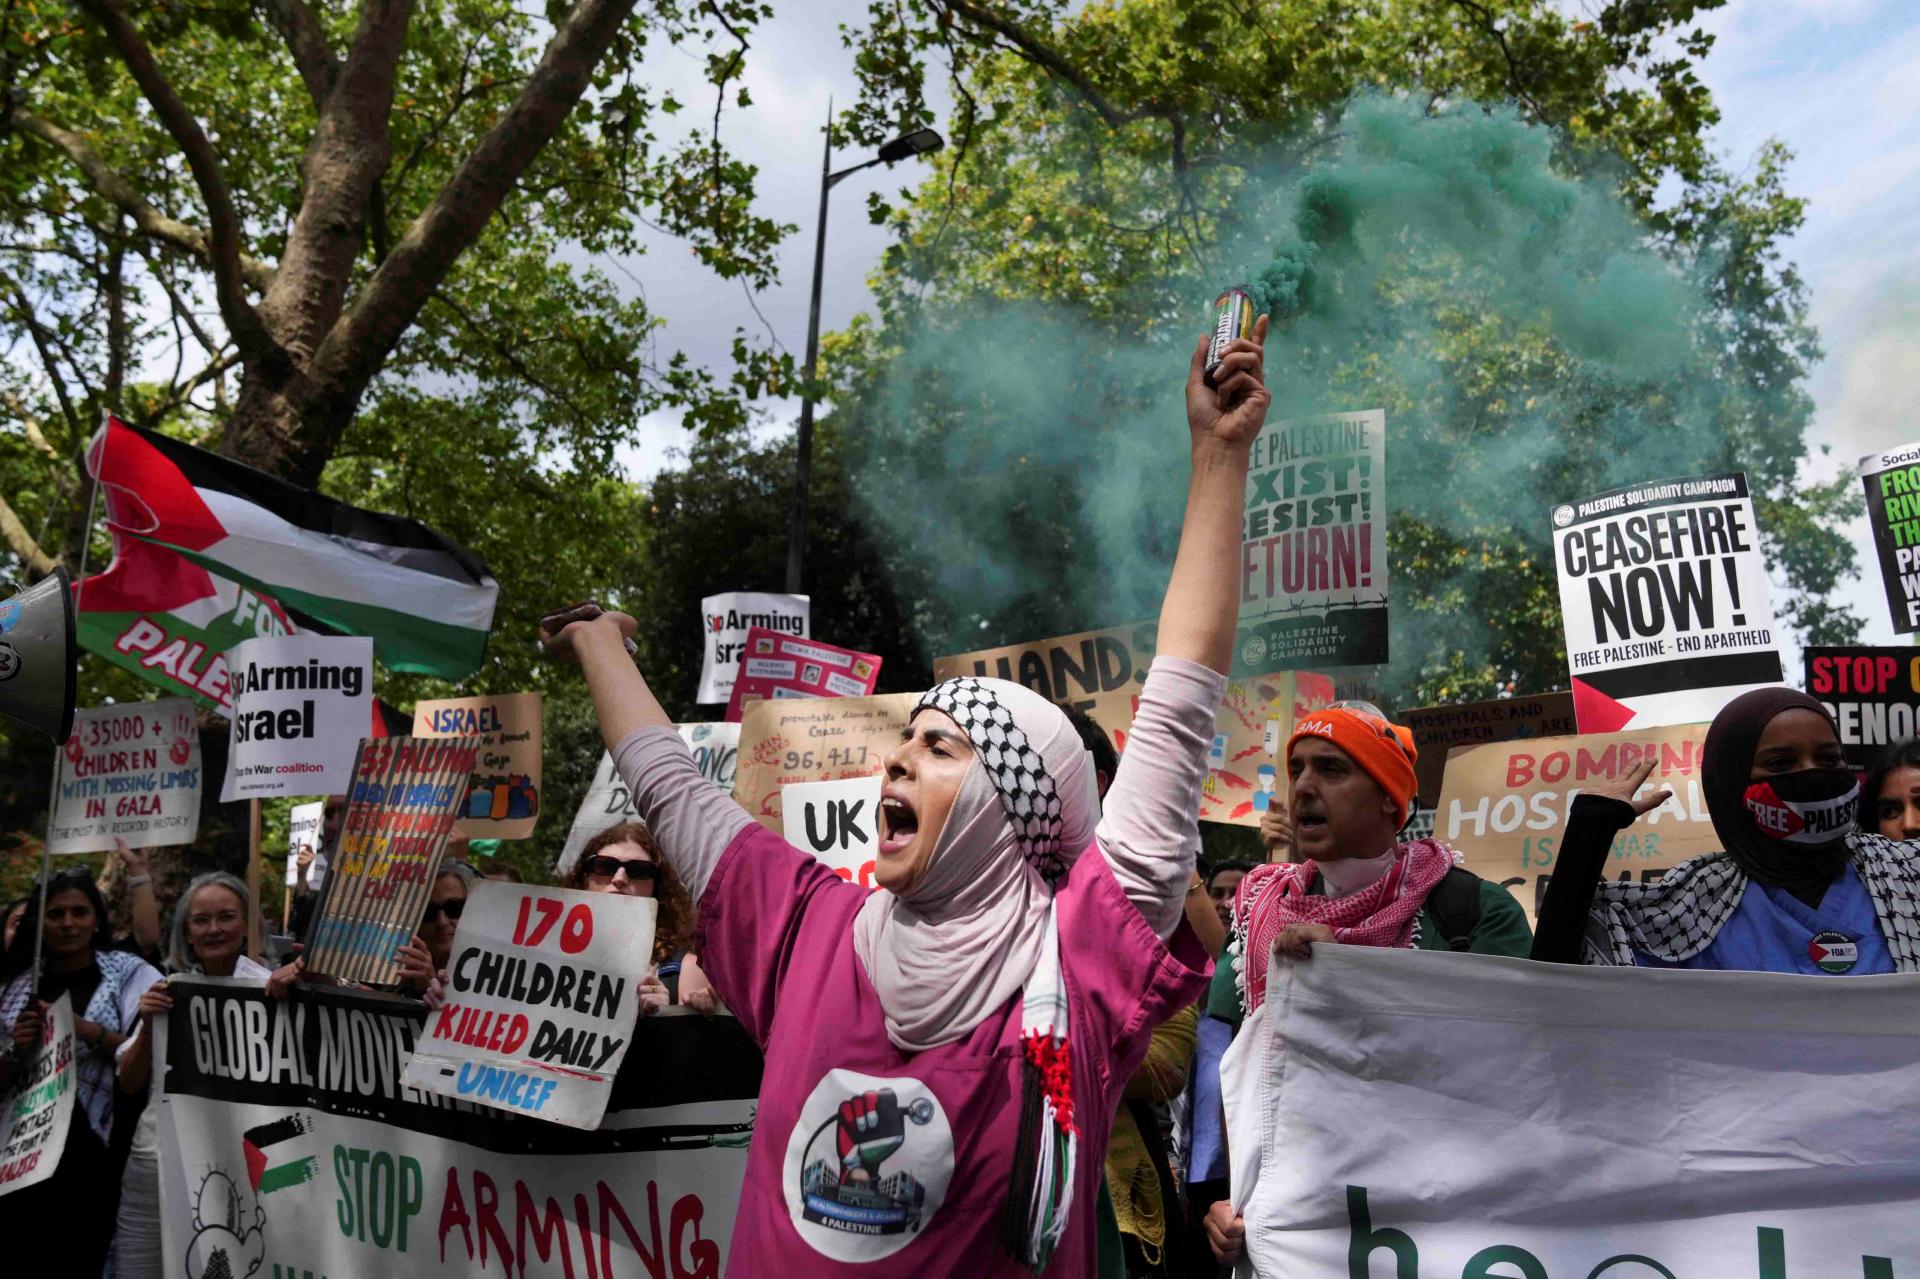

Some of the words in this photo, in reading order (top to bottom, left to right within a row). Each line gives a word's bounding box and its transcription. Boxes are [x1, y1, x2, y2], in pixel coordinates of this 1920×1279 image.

[1268, 420, 1370, 465] PALESTINE
[1247, 456, 1372, 509] XIST!
[1578, 493, 1626, 518] PALESTINE
[1626, 483, 1682, 507] SOLIDARITY
[1683, 478, 1737, 497] CAMPAIGN
[1243, 492, 1371, 541] ESIST!
[1563, 504, 1751, 578] CEASEFIRE
[1242, 523, 1372, 602] ETURN!
[726, 610, 804, 636] Arming
[1270, 626, 1340, 640] PALESTINE
[1270, 635, 1347, 651] SOLIDARITY
[1270, 647, 1337, 661] CAMPAIGN
[1574, 652, 1602, 668] FREE
[1604, 640, 1666, 664] PALESTINE
[1676, 635, 1702, 653] END
[1704, 629, 1772, 650] APARTHEID
[246, 659, 363, 697] Arming
[1812, 656, 1897, 694] STOP
[90, 715, 144, 746] 35000
[237, 700, 315, 744] srael
[433, 705, 502, 733] ISRAEL
[1410, 707, 1504, 730] HOSPITALS
[1510, 703, 1543, 719] AND
[1415, 725, 1494, 746] CHILDREN
[1541, 718, 1574, 734] ARE
[75, 748, 157, 778] CHILDREN
[254, 765, 274, 775] War
[275, 763, 324, 774] coalition
[783, 746, 868, 771] 96,417
[63, 778, 99, 799] WITH
[104, 774, 158, 795] MISSING
[160, 767, 199, 790] LIMBS
[85, 799, 105, 819] IN
[116, 795, 162, 817] GAZA
[805, 799, 869, 852] UK
[1746, 798, 1790, 833] FREE
[1522, 837, 1554, 869] IS
[512, 896, 594, 954] 170
[453, 947, 625, 1019] CHILDREN
[190, 996, 314, 1087] GLOBAL
[432, 1003, 529, 1054] KILLED
[529, 1020, 624, 1071] DAILY
[457, 1061, 558, 1111] UNICEF
[333, 1144, 423, 1253] STOP
[438, 1166, 720, 1279] ARMING
[828, 1218, 882, 1234] PALESTINE
